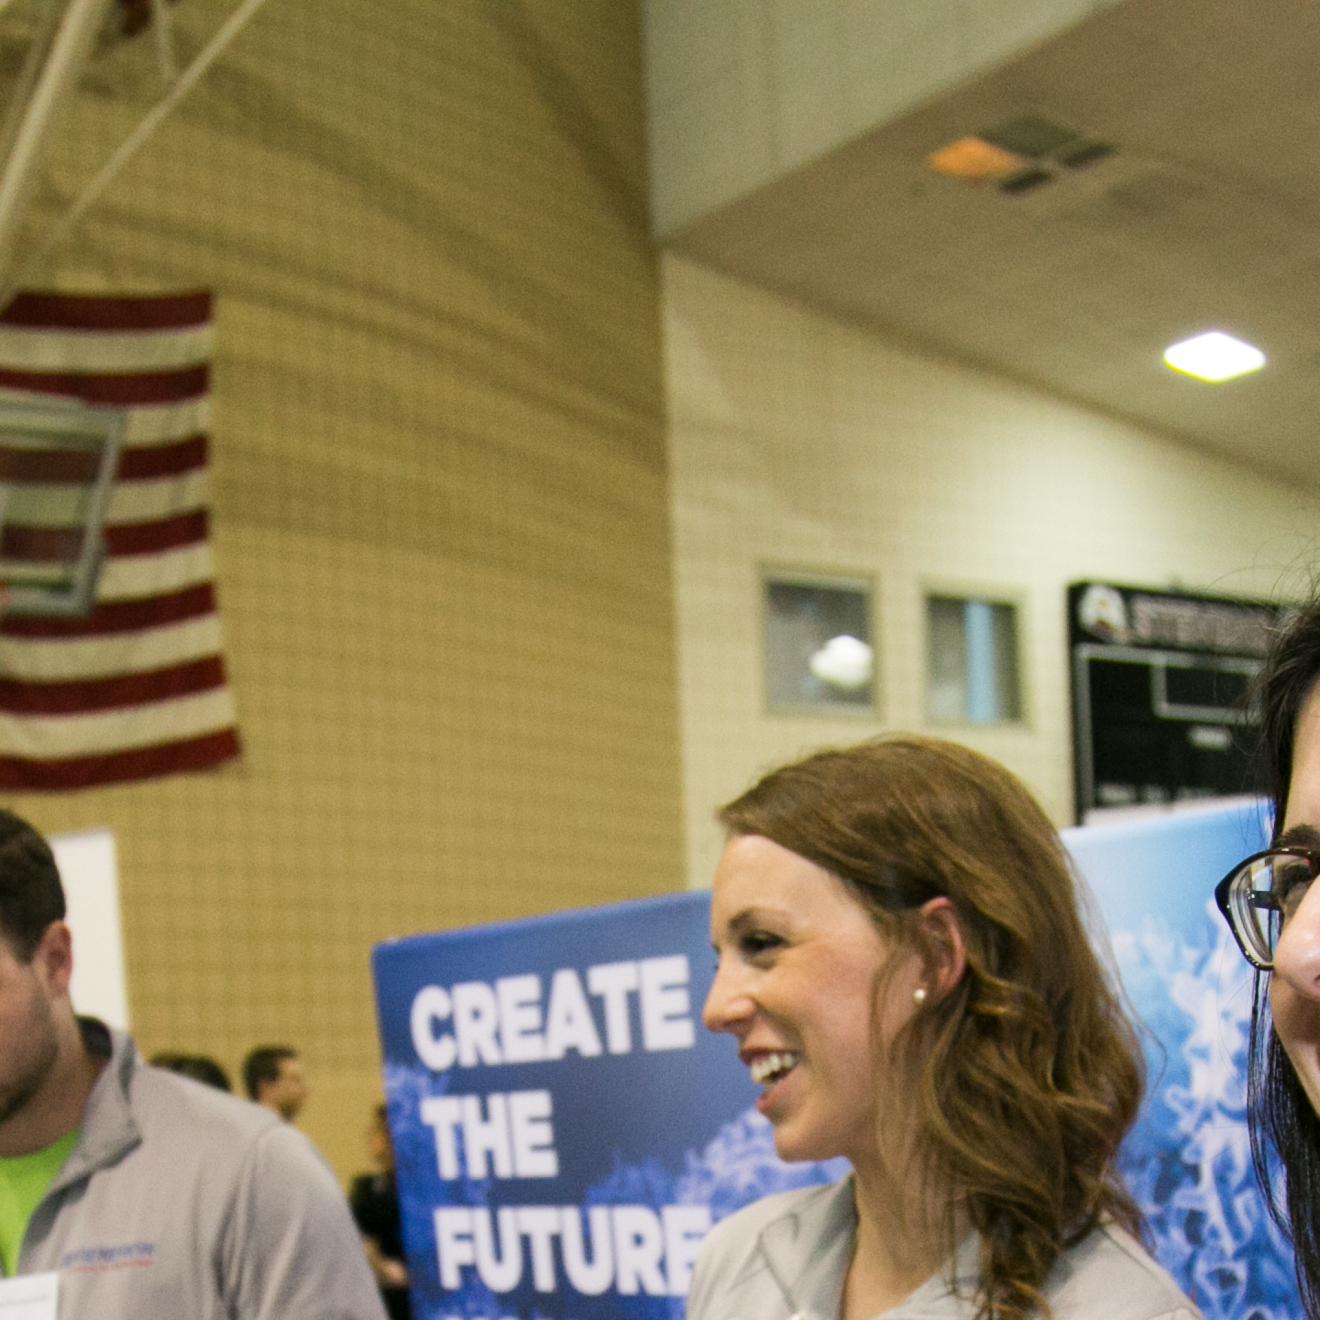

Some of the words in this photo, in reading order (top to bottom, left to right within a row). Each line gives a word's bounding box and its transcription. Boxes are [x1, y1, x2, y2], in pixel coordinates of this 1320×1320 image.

[411, 954, 695, 1072] CREATE
[419, 1090, 560, 1181] THE
[433, 1205, 712, 1296] FUTURE
